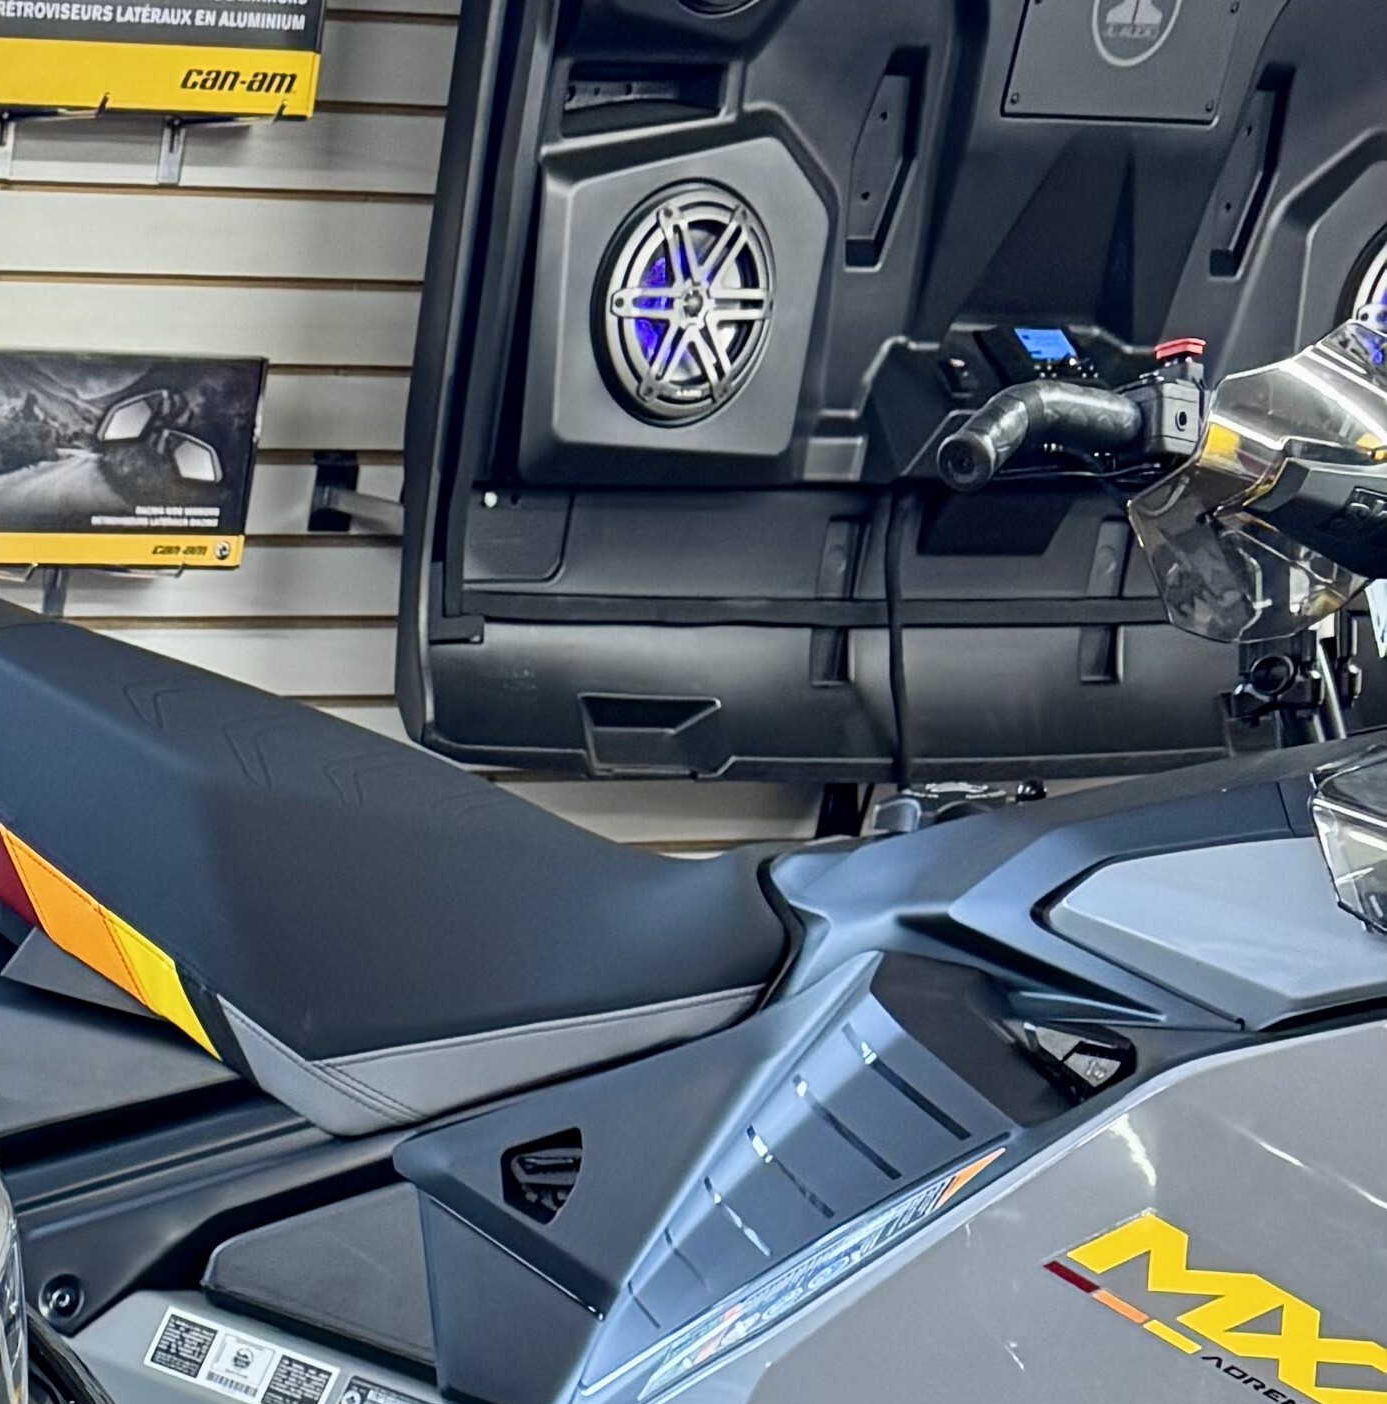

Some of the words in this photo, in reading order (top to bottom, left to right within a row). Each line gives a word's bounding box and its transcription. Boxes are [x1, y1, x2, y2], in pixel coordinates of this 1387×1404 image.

[115, 3, 192, 25] LATÉRAUX
[194, 9, 217, 27] EN
[218, 10, 306, 31] ALUMINIUM
[180, 68, 297, 94] can-am
